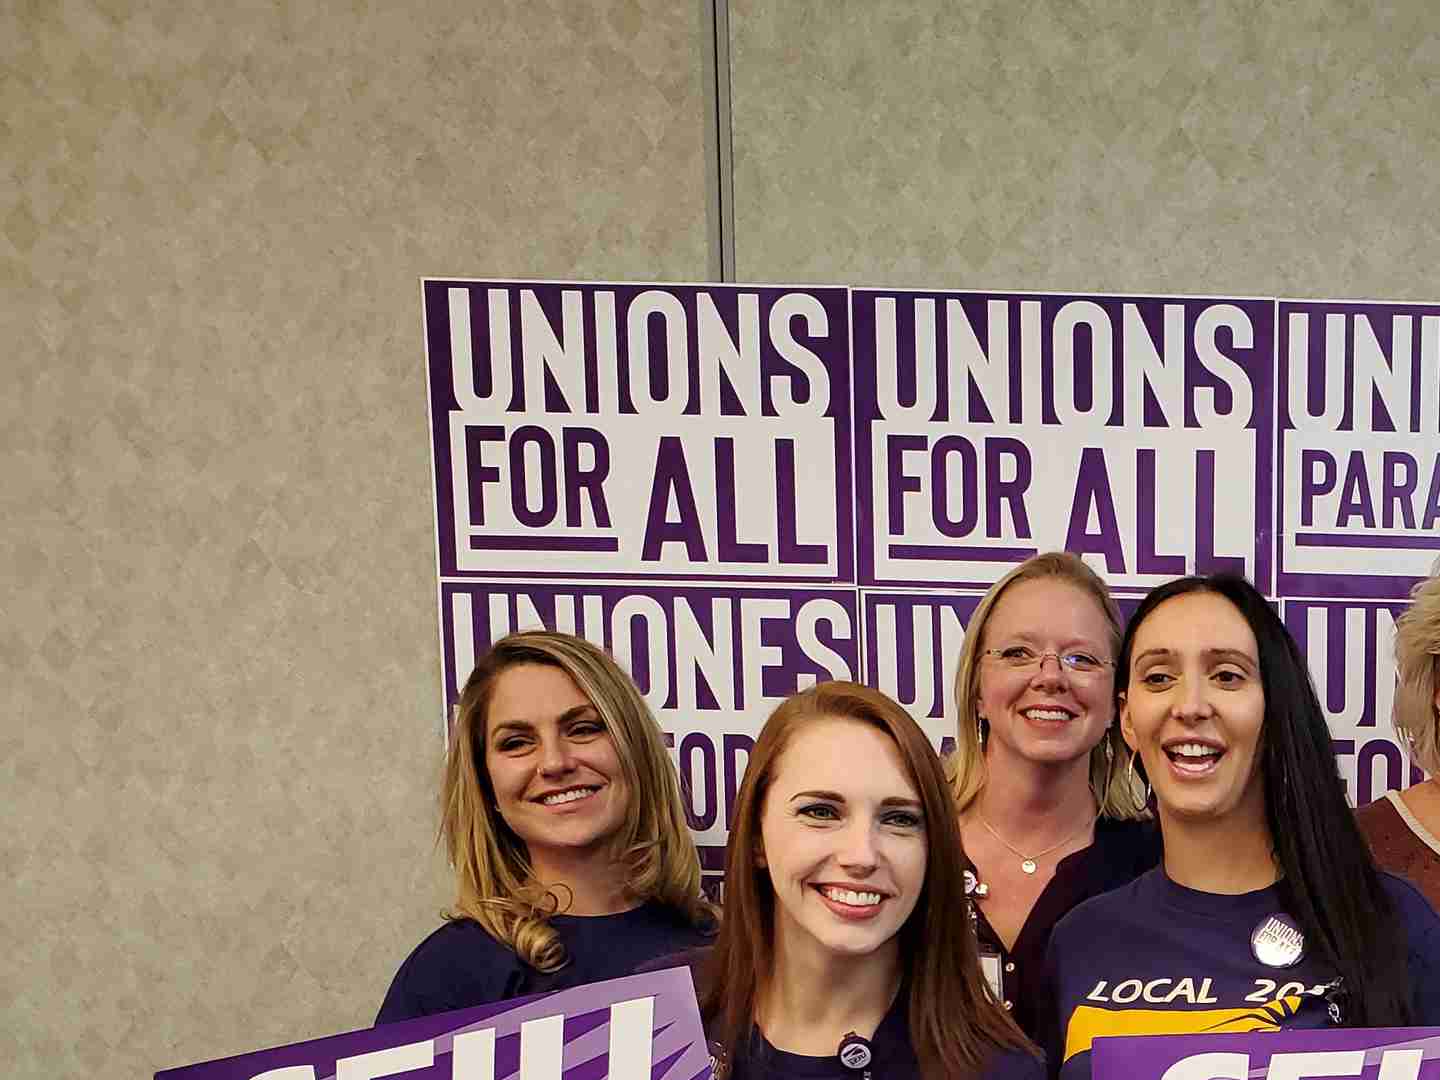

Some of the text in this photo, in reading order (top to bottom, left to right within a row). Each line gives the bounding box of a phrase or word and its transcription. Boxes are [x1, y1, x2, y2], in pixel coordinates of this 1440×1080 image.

[448, 288, 831, 418] UNIONS
[874, 297, 1254, 429] UNIONS
[464, 425, 829, 565] FOR ALL
[886, 434, 1246, 580] FOR ALL
[1086, 977, 1312, 1003] LOCAL 20
